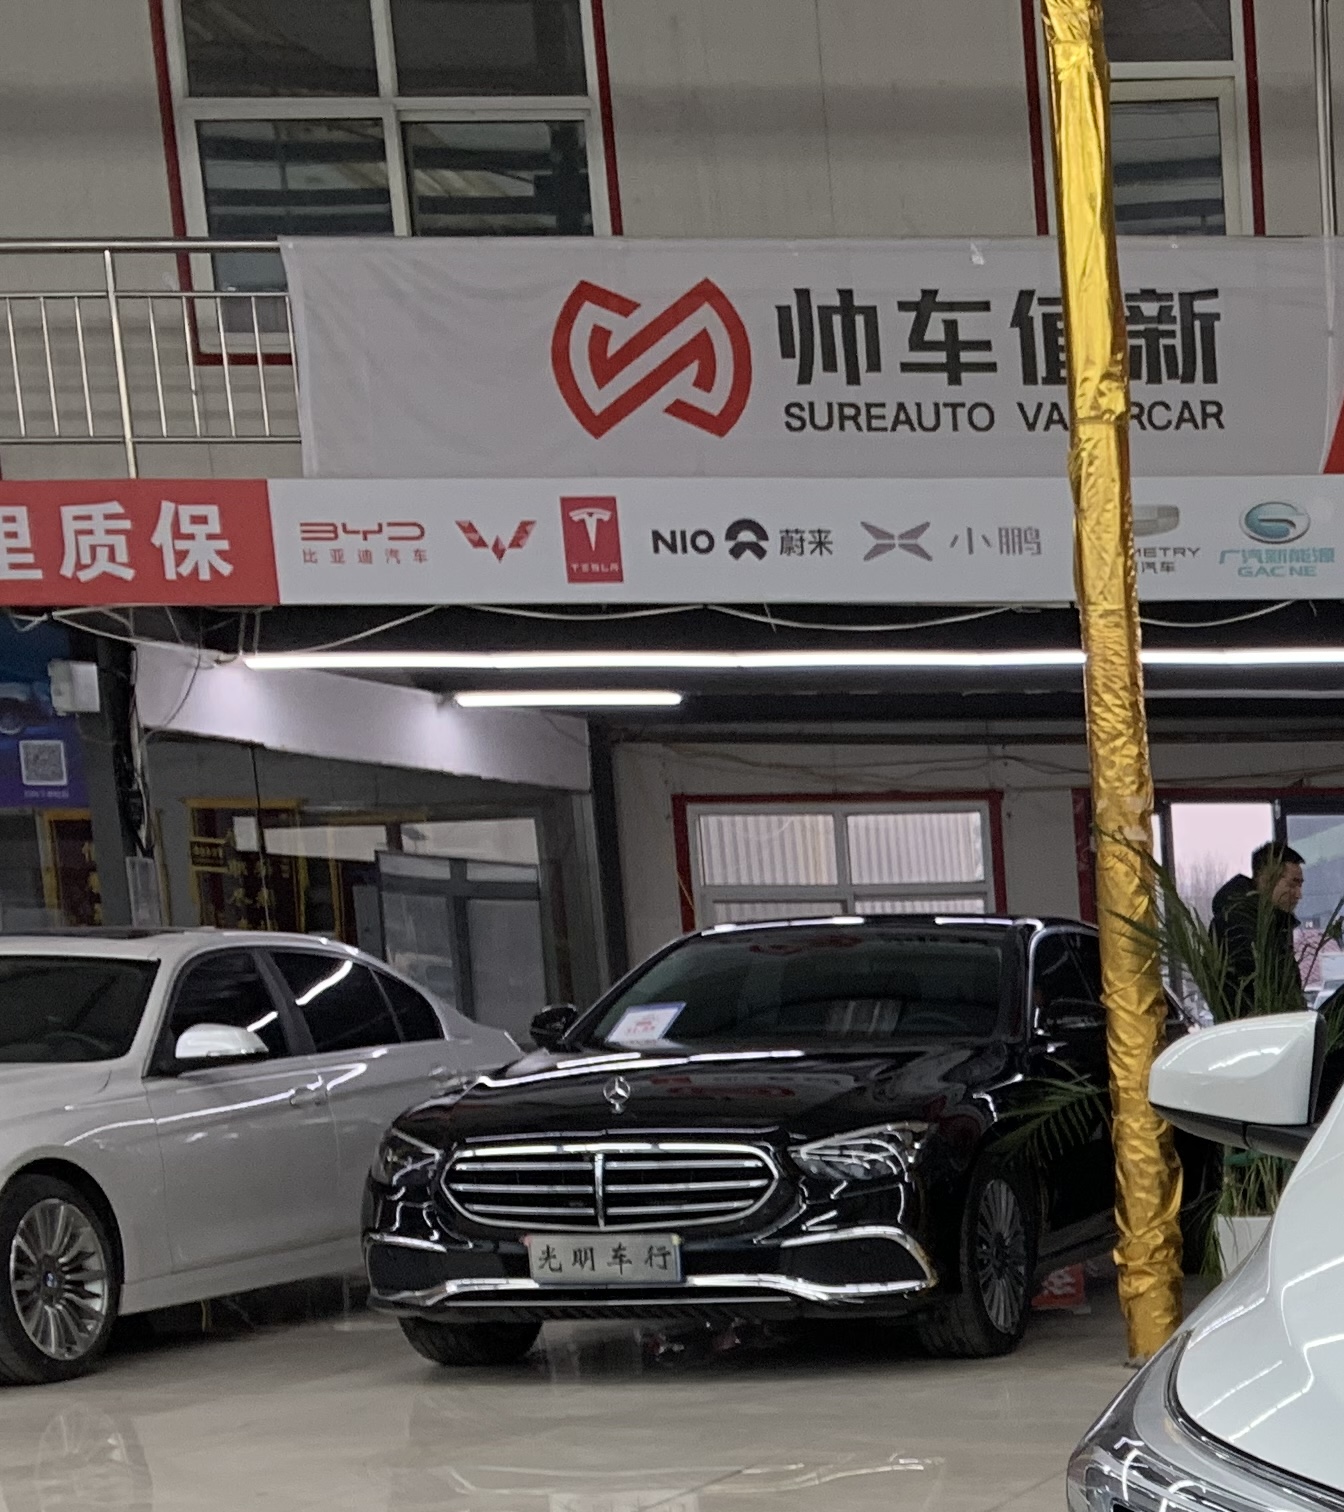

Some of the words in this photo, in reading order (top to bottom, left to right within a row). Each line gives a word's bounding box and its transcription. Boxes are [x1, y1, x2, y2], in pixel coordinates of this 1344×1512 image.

[783, 401, 996, 433] SUREAUTO
[1015, 400, 1226, 432] VARCAR
[299, 521, 426, 542] BYD
[949, 526, 1042, 556] 小鹏
[651, 528, 716, 555] NIO
[778, 528, 834, 557] 蔚来
[302, 548, 428, 565] 比亚迪汽车
[1218, 547, 1336, 565] 广汽新能源
[570, 562, 620, 573] TESLA
[1237, 566, 1283, 578] GAC
[1288, 566, 1318, 577] NE
[537, 1241, 672, 1276] 光明车行
